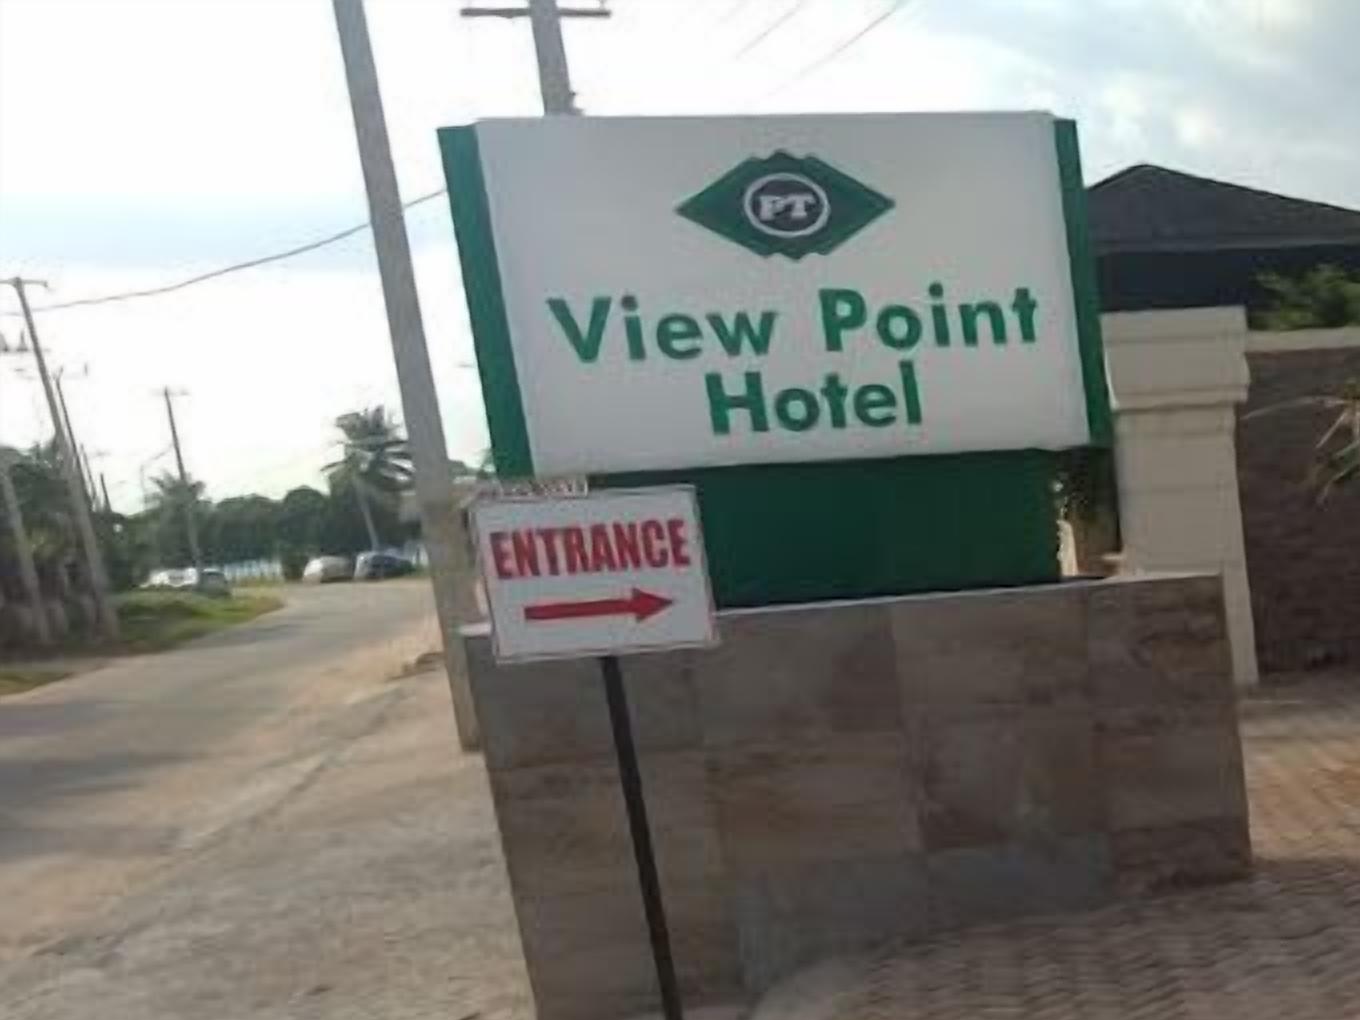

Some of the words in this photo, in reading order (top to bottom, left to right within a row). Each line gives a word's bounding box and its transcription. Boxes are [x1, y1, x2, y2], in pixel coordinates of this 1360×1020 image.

[760, 193, 816, 220] PT
[547, 295, 778, 363] View
[818, 282, 1038, 352] Point
[705, 360, 923, 435] Hotel
[489, 518, 691, 580] ENTRANCE
